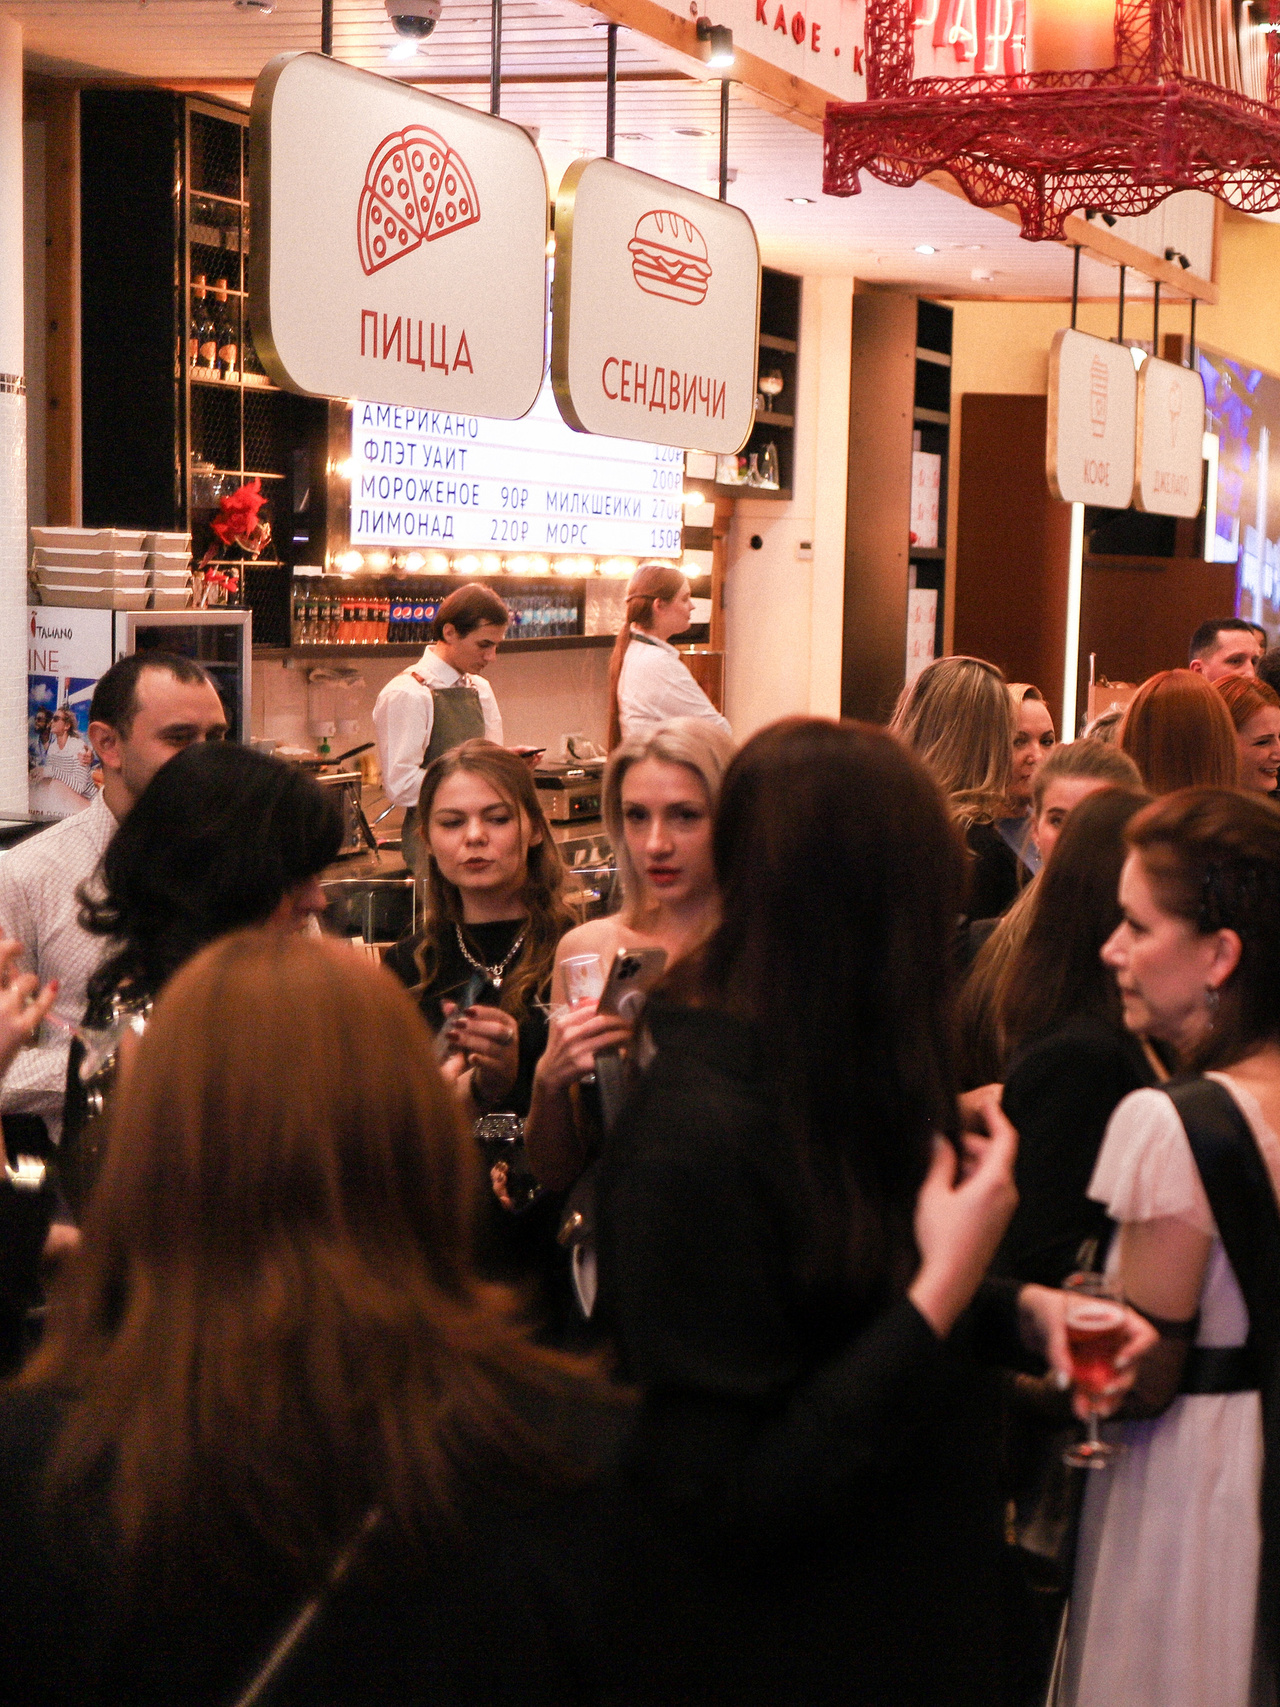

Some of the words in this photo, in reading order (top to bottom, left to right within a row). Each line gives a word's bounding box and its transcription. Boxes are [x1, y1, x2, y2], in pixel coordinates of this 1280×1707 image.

[755, 0, 821, 52] КАФЕ
[361, 309, 474, 376] ПИЦЦА
[602, 356, 726, 420] СЕНДВИЧИ
[362, 404, 479, 438] АМЕРИКАНО
[364, 438, 417, 466] ФЛЭТ
[361, 475, 480, 506] МОРОЖЕНОЕ
[546, 490, 642, 517] МИЛКШЕЙКИ
[357, 509, 454, 540] ЛИМОНАД
[546, 523, 588, 545] МОРС
